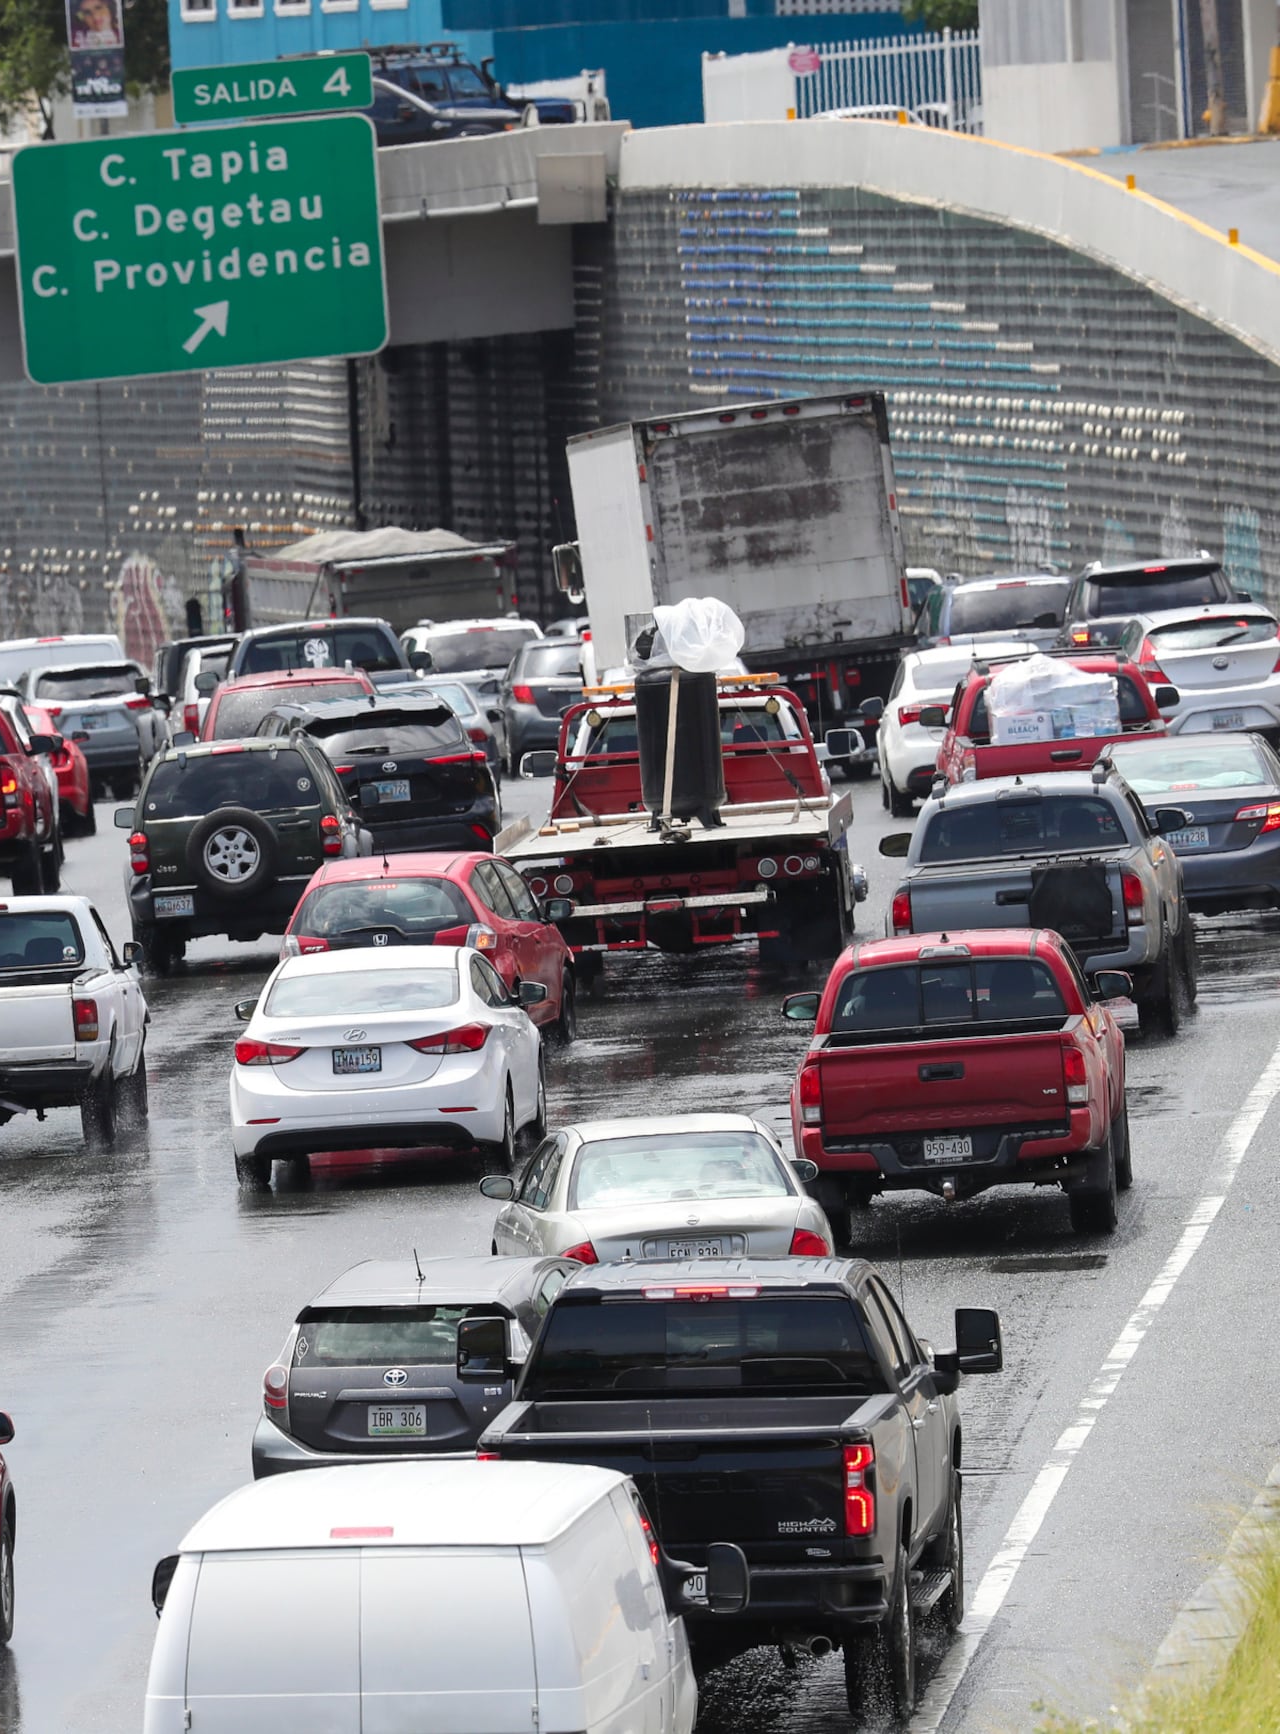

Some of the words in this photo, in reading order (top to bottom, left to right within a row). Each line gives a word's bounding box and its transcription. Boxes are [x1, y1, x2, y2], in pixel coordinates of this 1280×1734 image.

[193, 77, 297, 106] SALIDA
[322, 66, 352, 98] 4
[100, 153, 137, 187] C.
[162, 141, 289, 184] Tapia
[72, 208, 109, 242] C.
[134, 193, 324, 240] Degetau
[31, 264, 69, 298] C.
[93, 236, 371, 293] Providencia
[1007, 725, 1039, 735] BLEACH
[1190, 832, 1206, 843] 238
[156, 865, 178, 874] Jeep
[175, 900, 191, 912] 637
[360, 1054, 377, 1066] 159
[925, 1141, 970, 1156] 959-430
[371, 1411, 393, 1427] IBR
[400, 1411, 422, 1427] 306
[777, 1526, 837, 1534] COUNTRY
